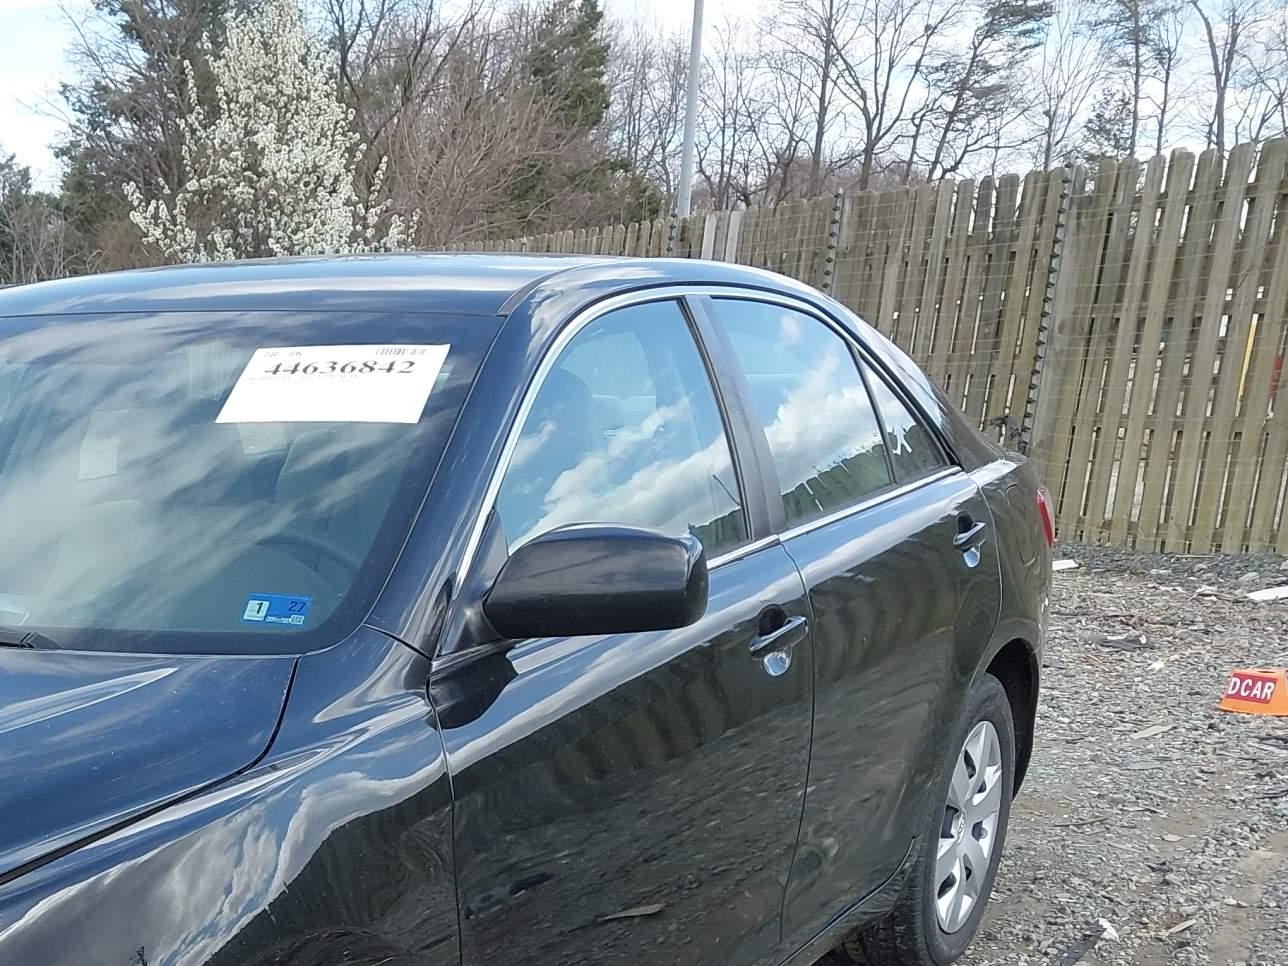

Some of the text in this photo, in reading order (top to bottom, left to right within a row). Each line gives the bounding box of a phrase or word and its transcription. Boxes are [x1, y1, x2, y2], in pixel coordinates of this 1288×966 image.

[264, 360, 416, 375] 44636842
[256, 601, 306, 615] 1 27
[1227, 677, 1275, 700] DCAR
